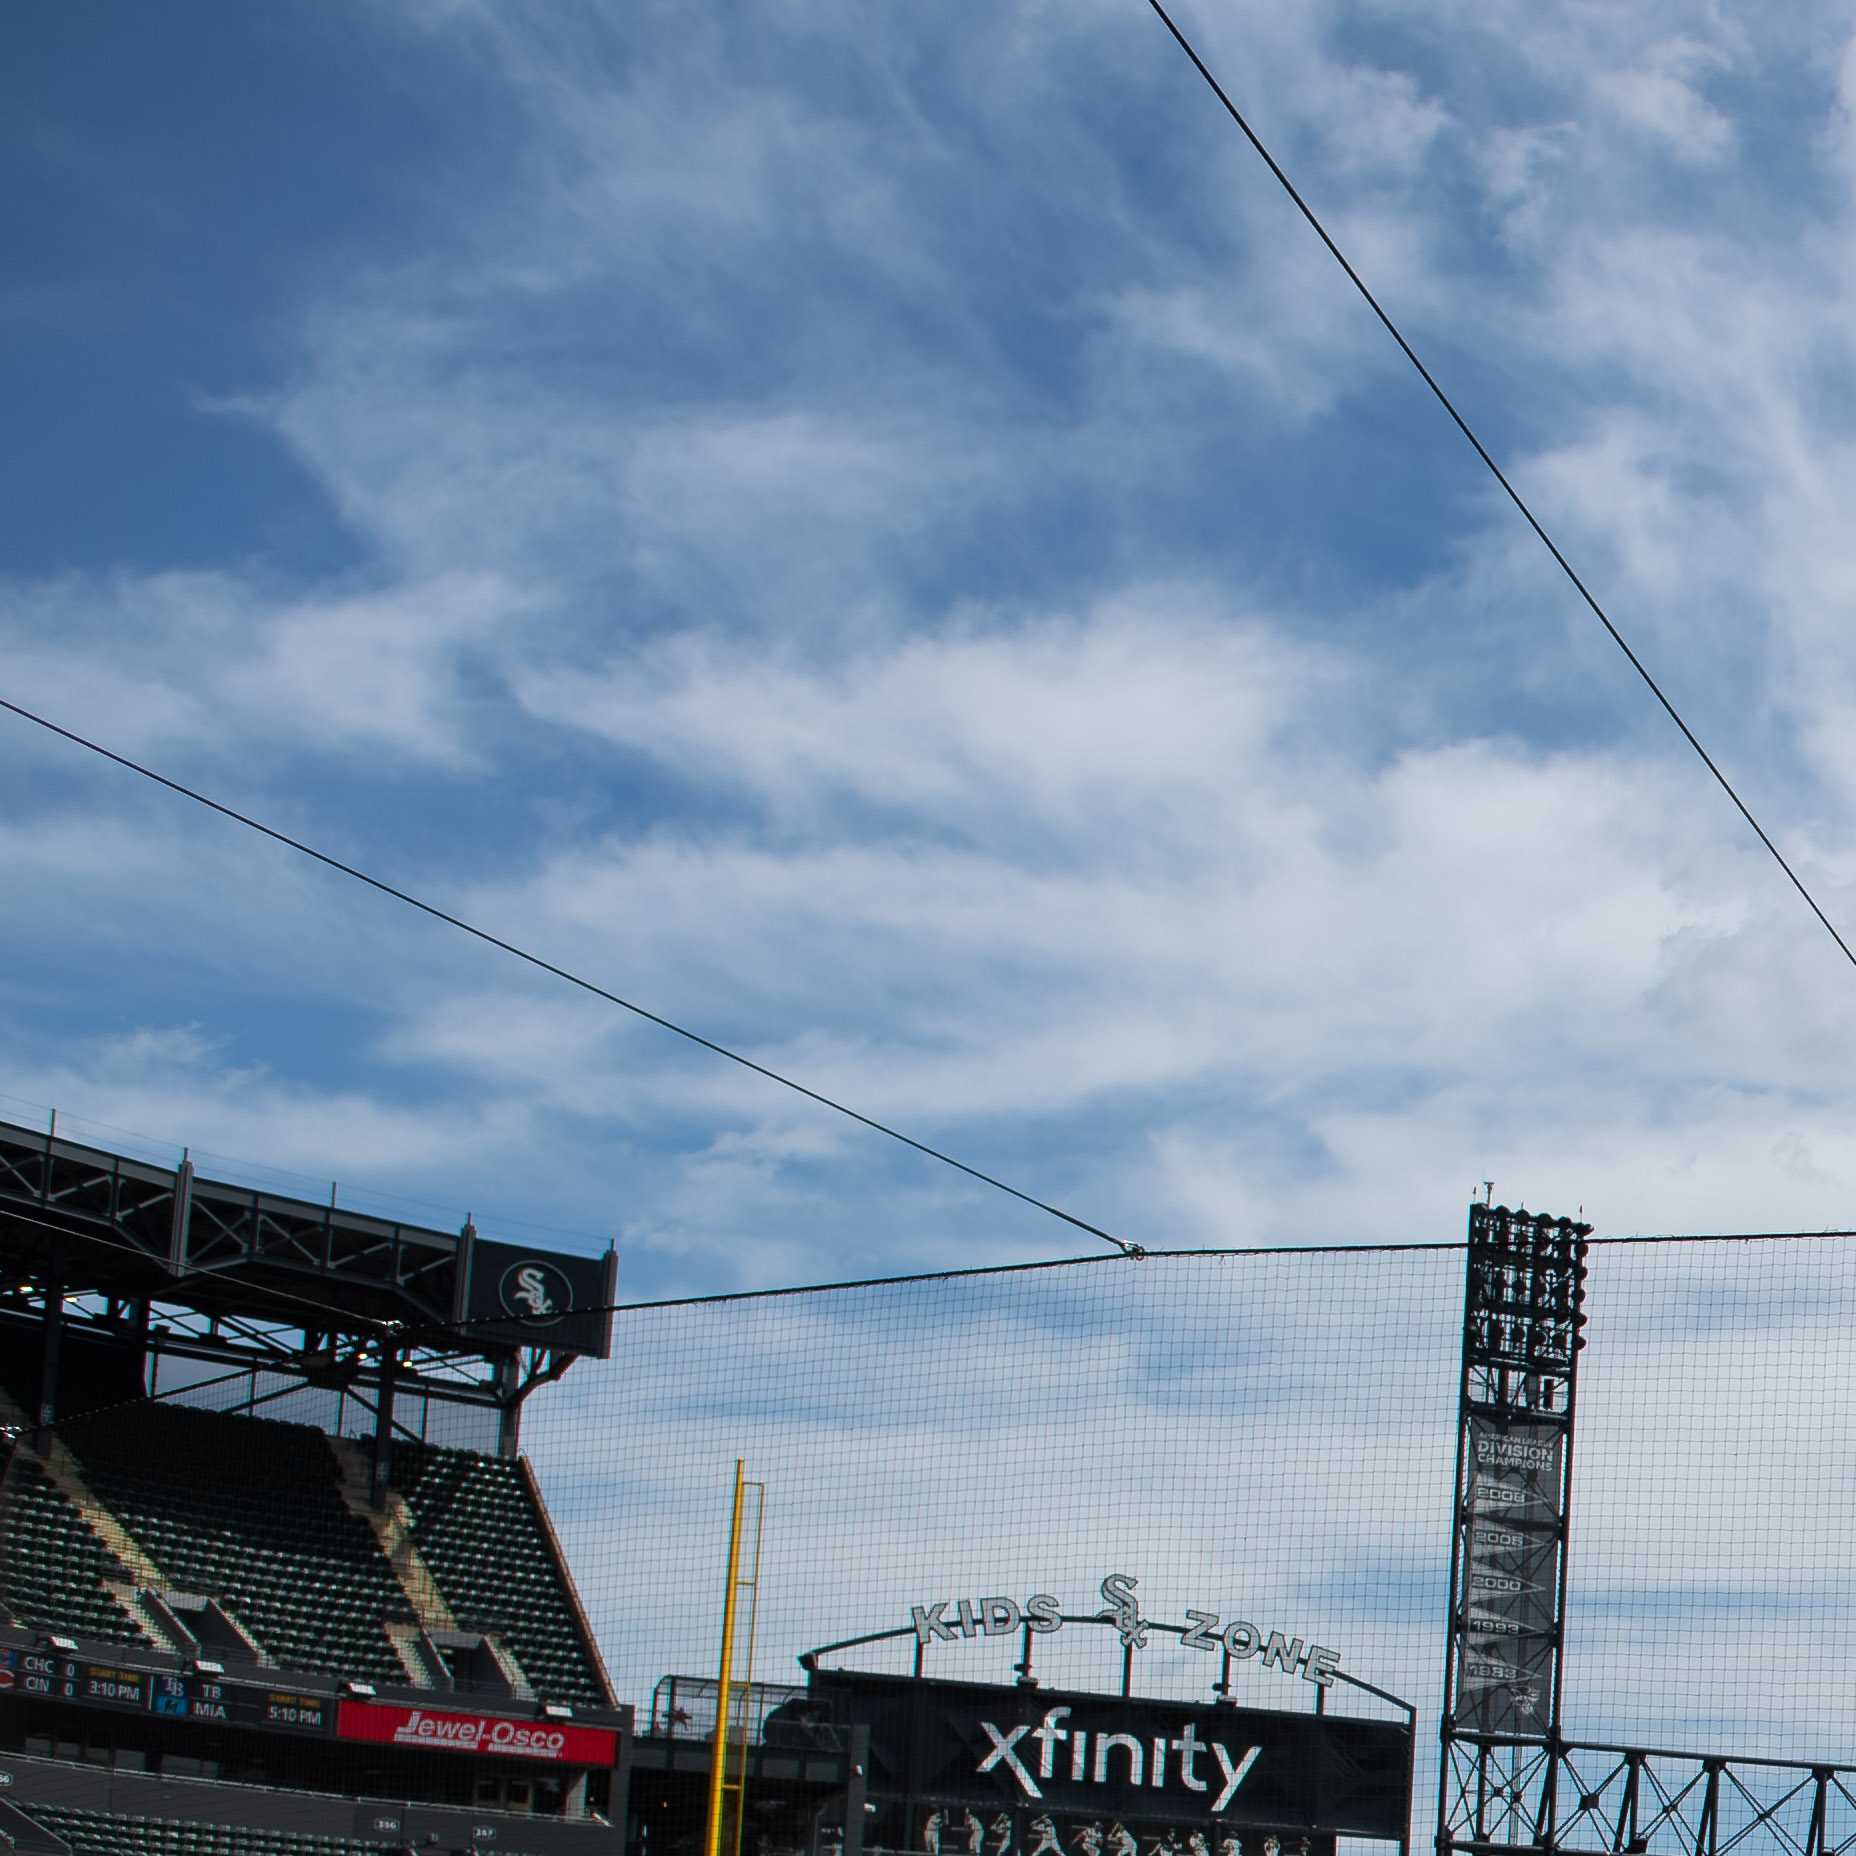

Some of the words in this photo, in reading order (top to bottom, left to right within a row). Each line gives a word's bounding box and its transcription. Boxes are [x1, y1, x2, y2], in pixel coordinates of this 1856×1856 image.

[1479, 1441, 1553, 1461] DIVISION
[912, 1594, 1062, 1644] KIDS
[1181, 1610, 1341, 1686] ZONE
[24, 1656, 54, 1673] CHC
[118, 1686, 140, 1701] PM
[394, 1711, 565, 1757] Jewel-Osco
[977, 1707, 1261, 1811] xfinity
